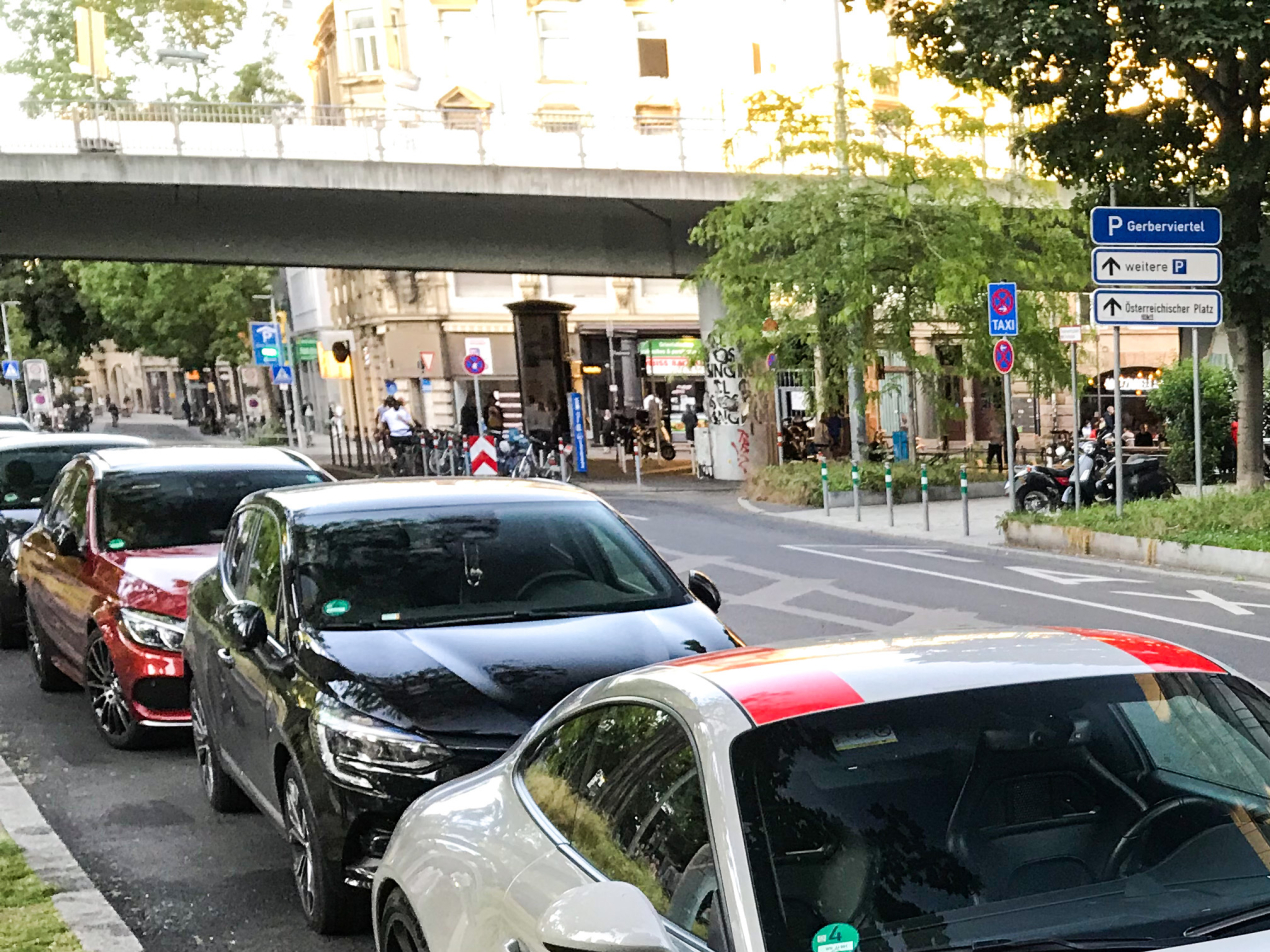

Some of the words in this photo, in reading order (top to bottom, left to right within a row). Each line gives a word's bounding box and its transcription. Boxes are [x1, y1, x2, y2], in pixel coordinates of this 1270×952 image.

[1108, 215, 1123, 236] P
[1127, 220, 1205, 232] Gerberviertel
[1125, 262, 1168, 272] weitere
[1125, 301, 1190, 314] Österreichischer
[1193, 303, 1214, 314] Platz
[992, 319, 1015, 331] TAXI
[829, 925, 842, 941] 4
